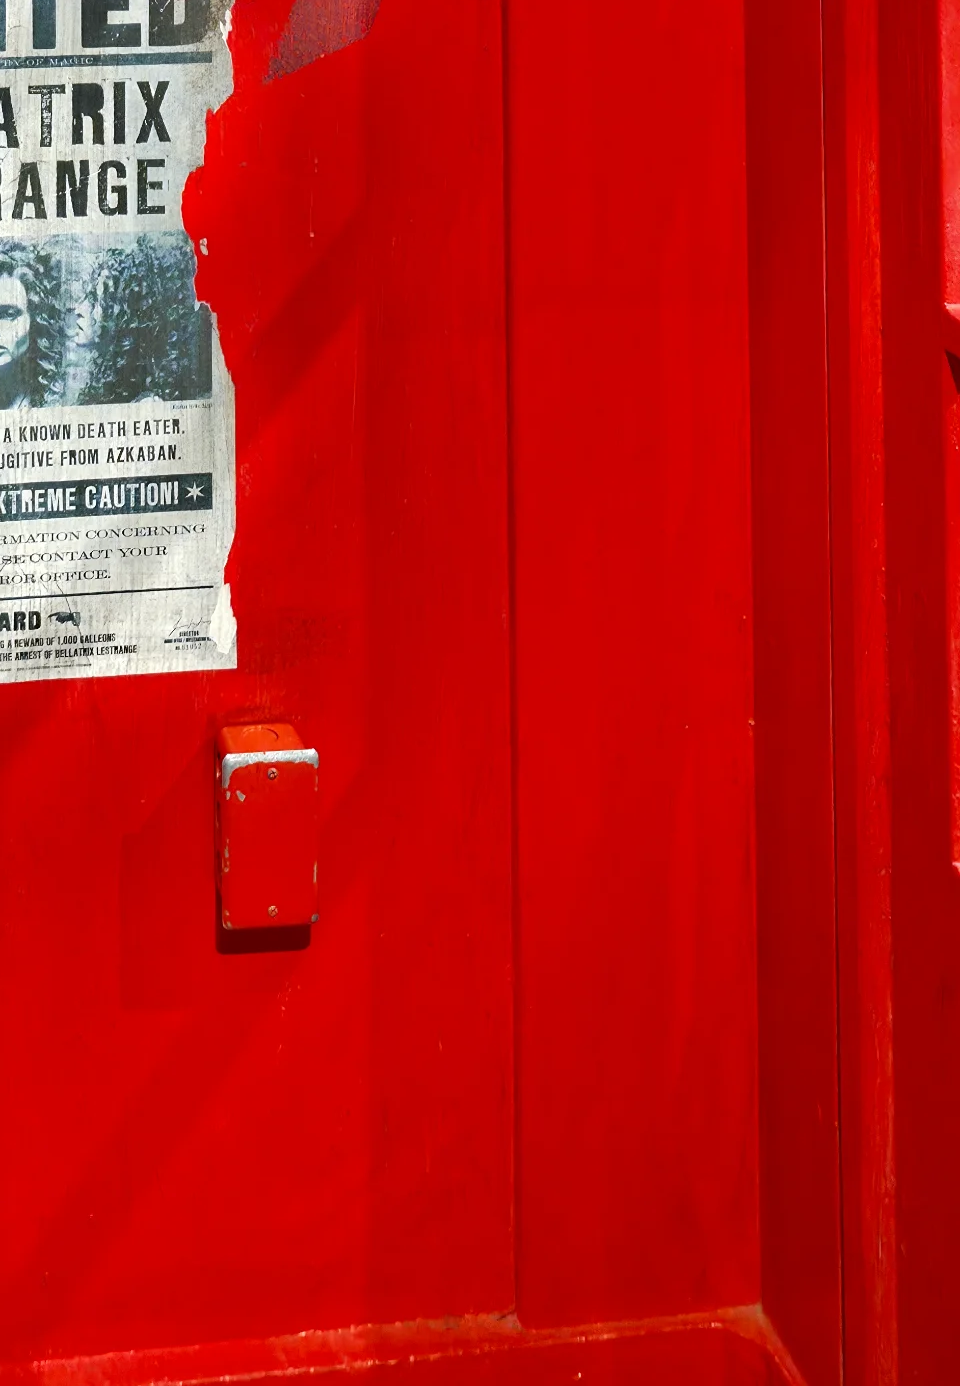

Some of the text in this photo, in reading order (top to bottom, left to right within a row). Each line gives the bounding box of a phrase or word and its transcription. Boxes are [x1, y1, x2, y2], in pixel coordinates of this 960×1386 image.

[3, 427, 12, 444] A
[18, 423, 71, 443] KNOWN
[77, 420, 127, 440] DEATH
[133, 418, 186, 437] EATER.
[60, 448, 99, 467] FROM
[106, 444, 182, 464] AZKABAN.
[84, 480, 179, 509] CAUTION!
[85, 523, 207, 540] CONCERNING
[28, 547, 114, 563] CONTACT
[116, 544, 169, 558] YOUR
[39, 569, 112, 585] OFFICE.
[14, 637, 44, 649] REWARD
[45, 636, 56, 647] OF
[43, 649, 53, 660] OF
[96, 644, 138, 656] LESTRANGE
